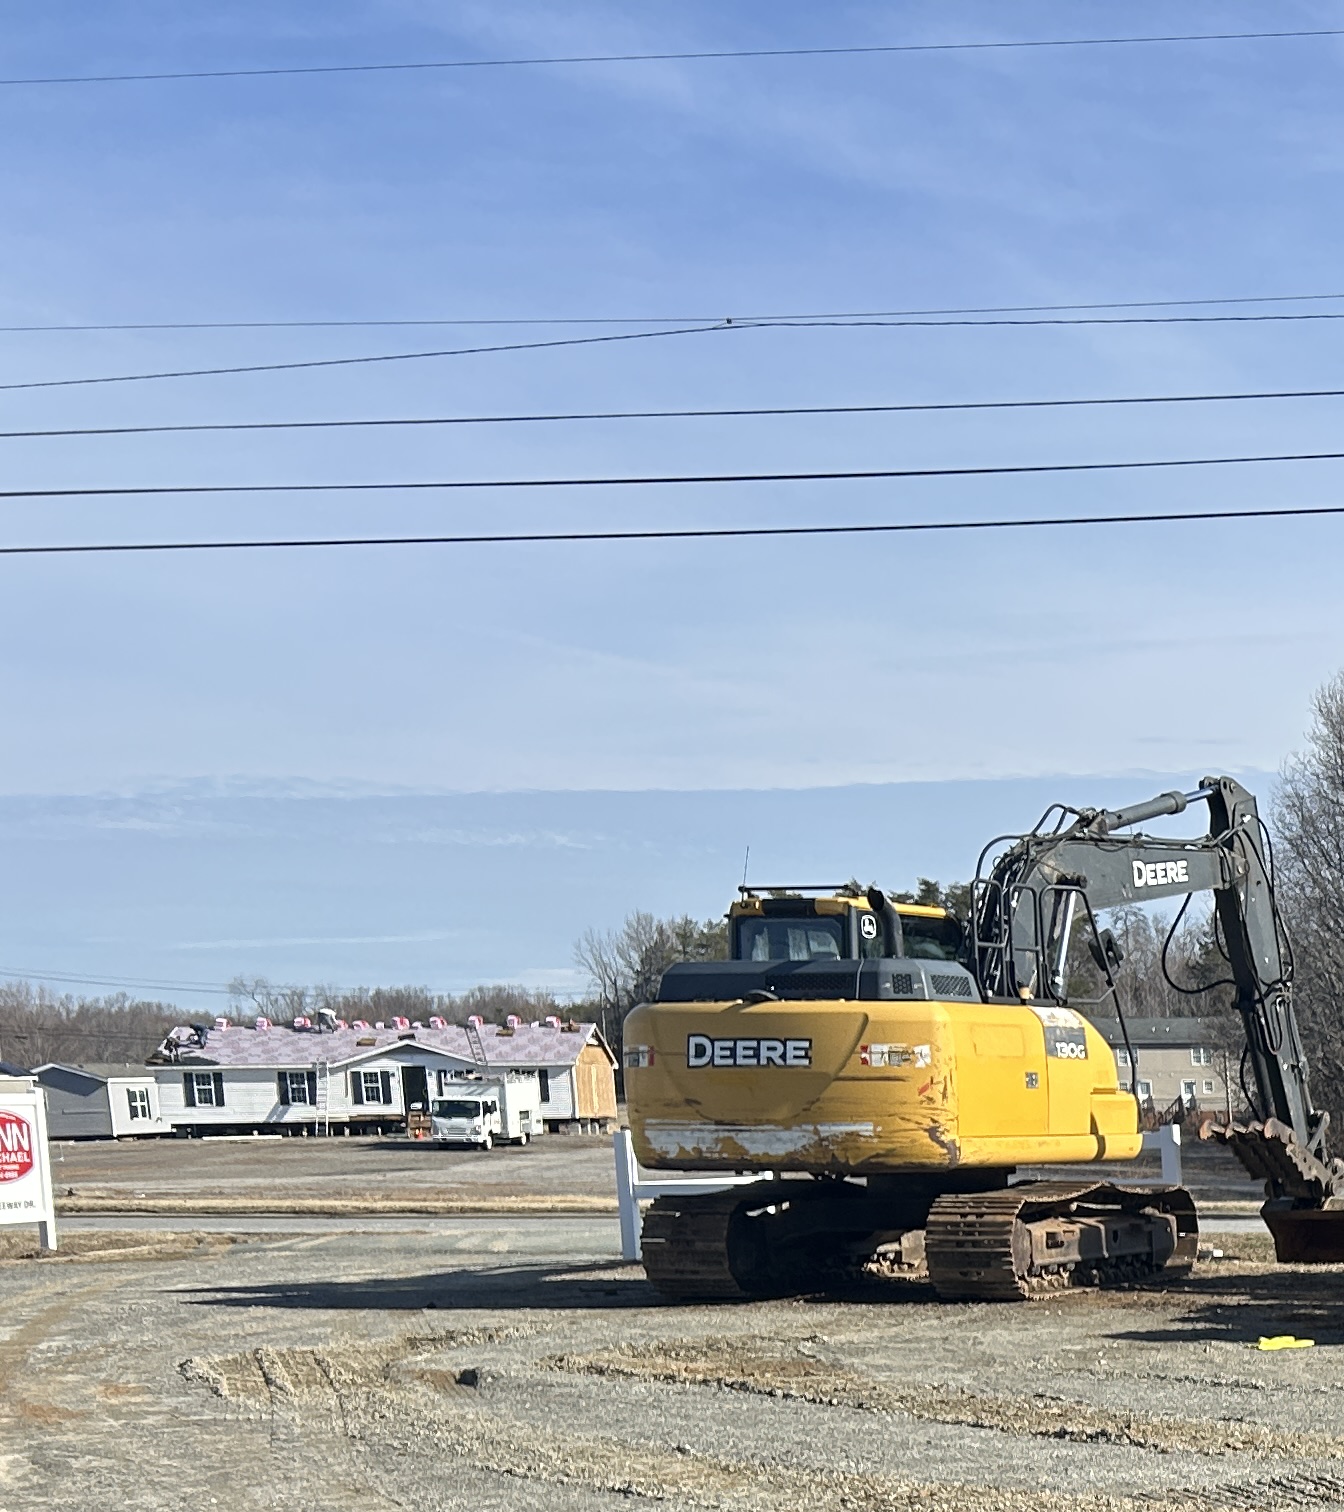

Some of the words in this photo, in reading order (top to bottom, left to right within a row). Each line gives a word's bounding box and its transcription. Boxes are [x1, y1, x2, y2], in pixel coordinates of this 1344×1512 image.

[1132, 860, 1189, 887] DEERE
[689, 1035, 810, 1066] DEERE
[1055, 1042, 1086, 1059] 130G
